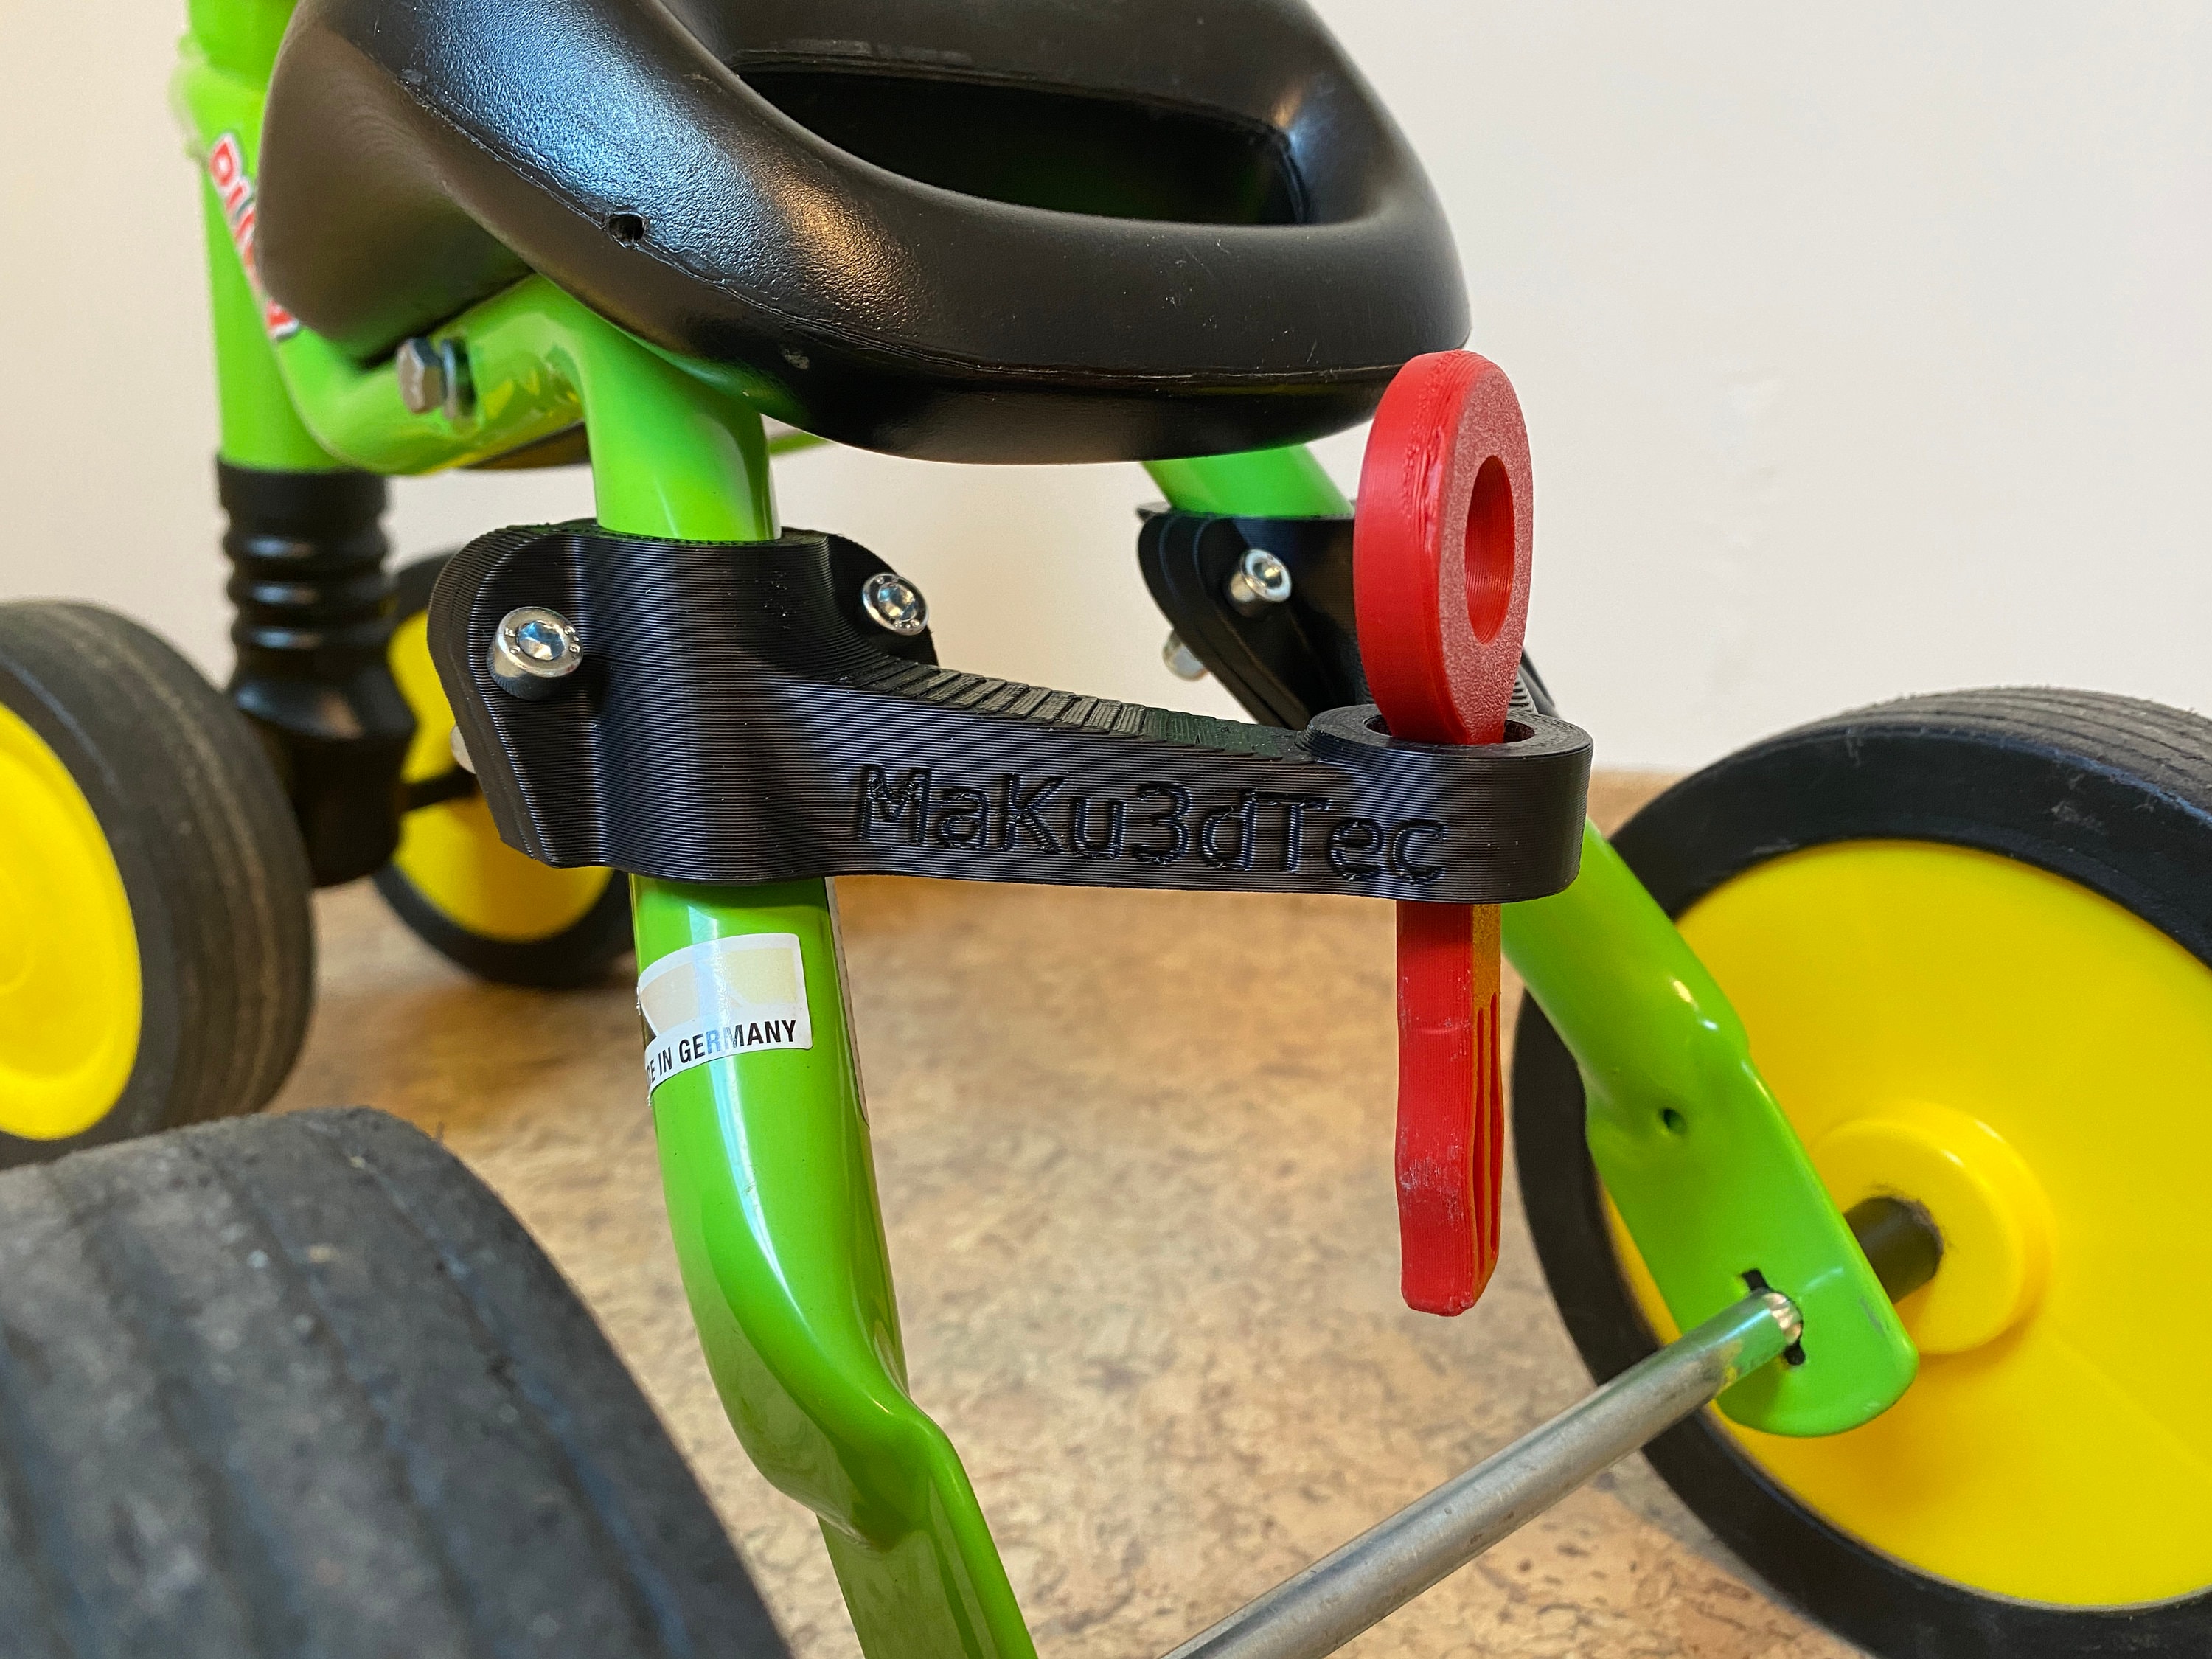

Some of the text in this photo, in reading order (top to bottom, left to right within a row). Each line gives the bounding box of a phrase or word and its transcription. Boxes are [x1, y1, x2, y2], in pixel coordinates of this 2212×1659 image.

[858, 764, 1446, 885] MaKu3dTec
[658, 1046, 672, 1076] IN
[678, 1020, 796, 1064] GERMANY
